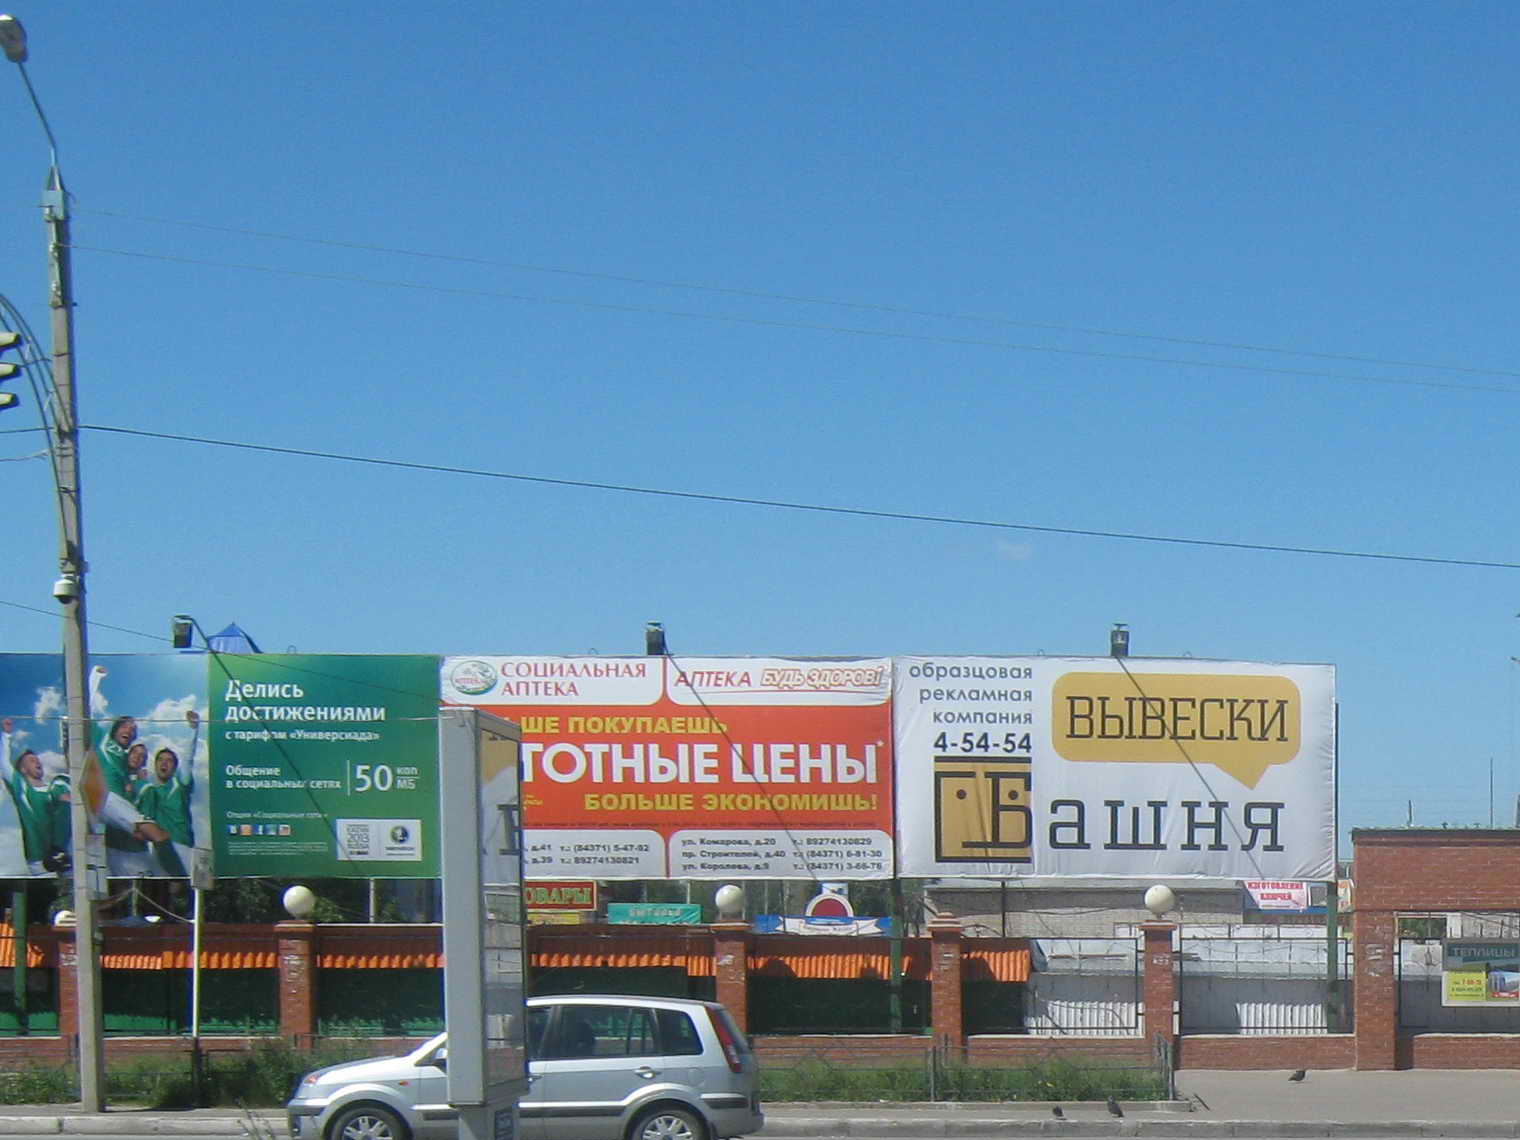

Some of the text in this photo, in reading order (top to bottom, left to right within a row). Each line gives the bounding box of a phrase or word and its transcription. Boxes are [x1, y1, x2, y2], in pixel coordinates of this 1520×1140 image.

[501, 662, 646, 680] СОЦИАЛЬНАЯ
[674, 671, 752, 687] АПТЕКА
[760, 668, 804, 688] БУДЬ
[909, 662, 1032, 681] образцовая
[225, 680, 304, 701] Делись
[501, 681, 579, 696] АПТЕКА
[919, 688, 1032, 704] рекламная
[225, 706, 386, 722] достижениями
[933, 710, 1032, 724] компания
[1066, 696, 1289, 742] ВЫВЕСКИ
[568, 716, 727, 734] ПОКУПАЕШЬ
[934, 732, 1032, 753] 4-54-54
[226, 765, 281, 777] Общение
[522, 742, 719, 784] ГОТНЫЕ
[309, 780, 341, 789] сетях
[355, 764, 393, 792] 50
[584, 793, 878, 811] БОЛЬШЕ ЭКОНОМИШЬ!
[525, 887, 592, 905] ОВАРЫ
